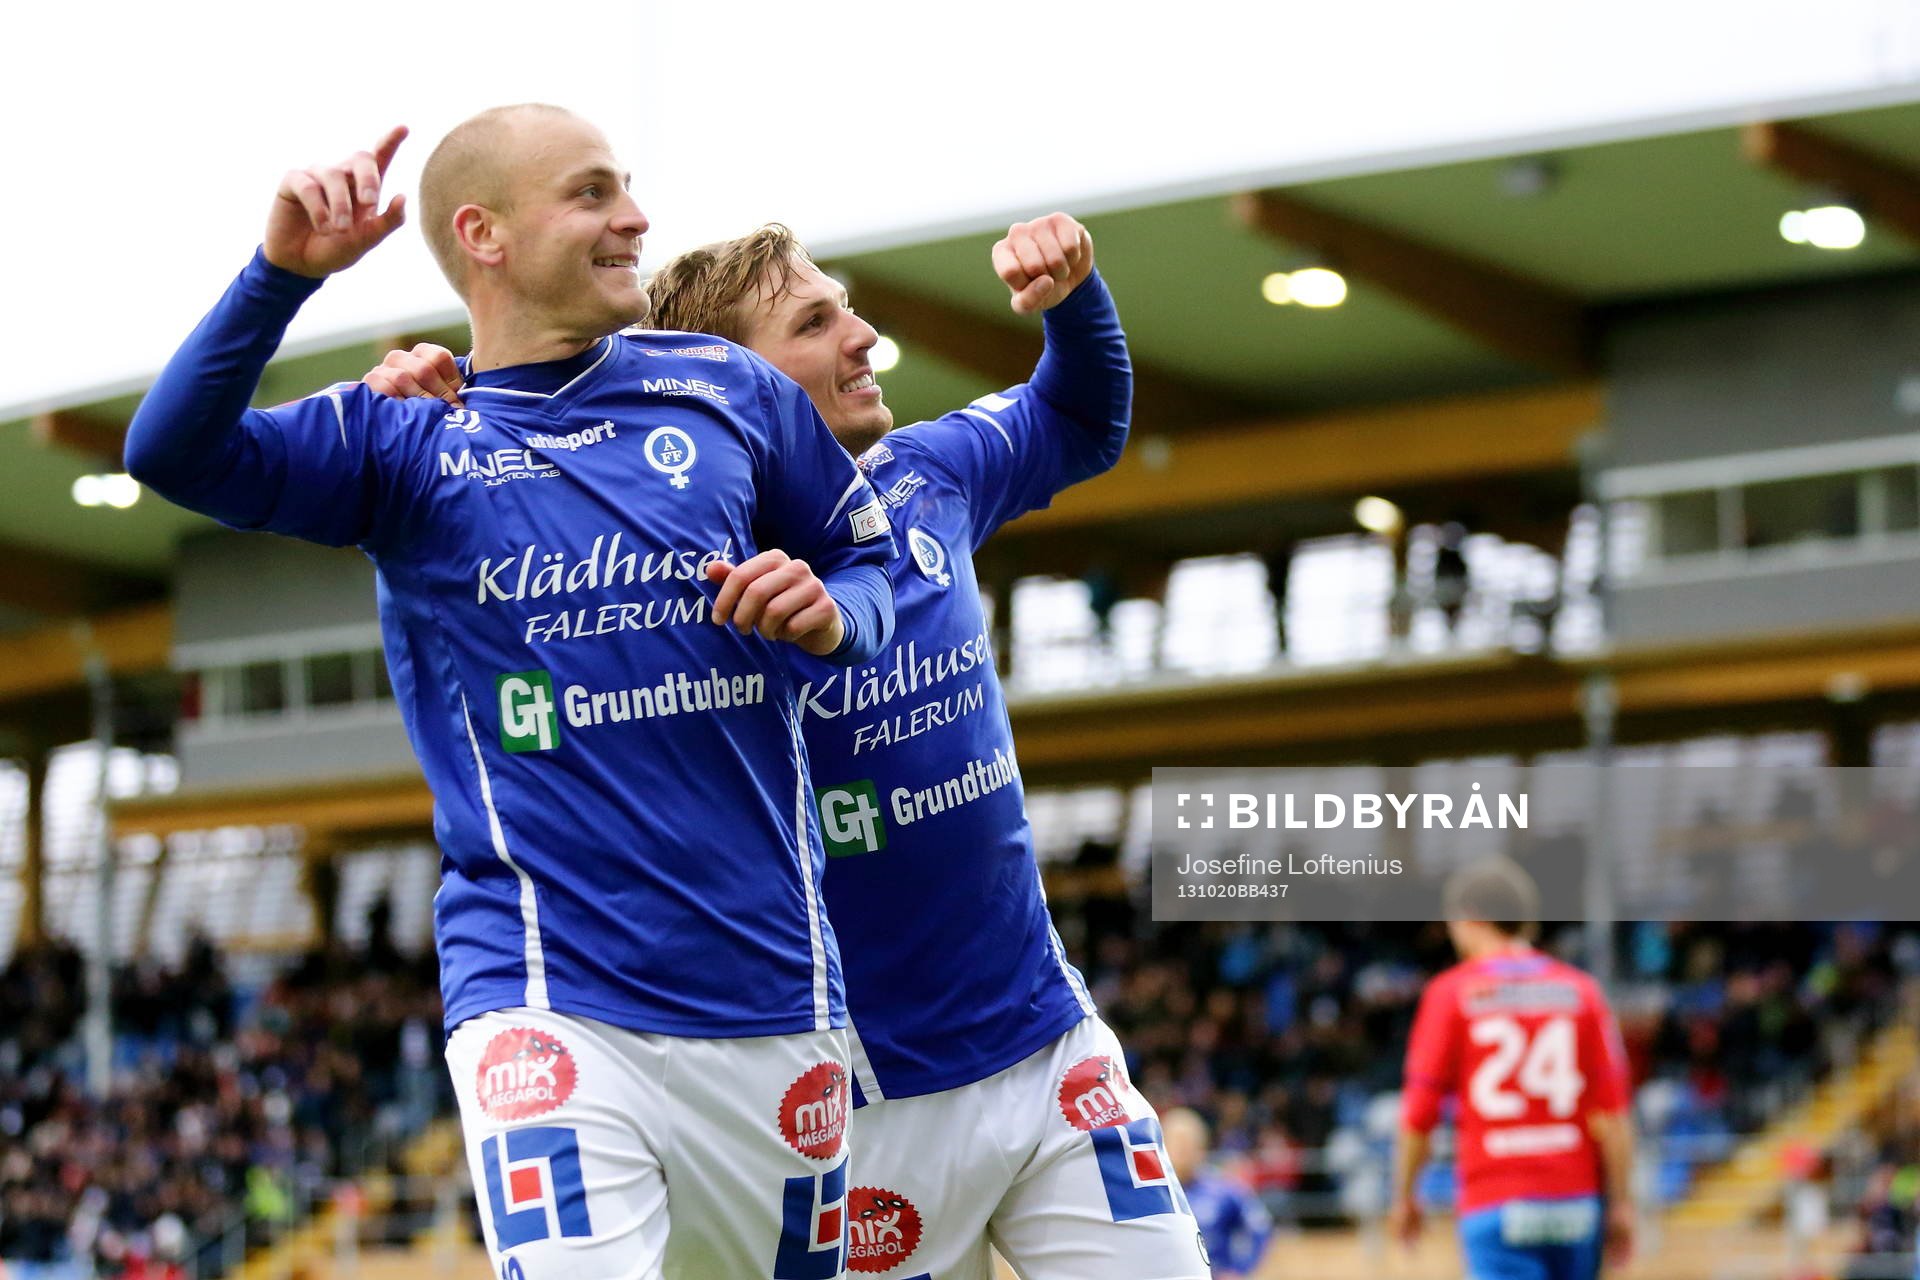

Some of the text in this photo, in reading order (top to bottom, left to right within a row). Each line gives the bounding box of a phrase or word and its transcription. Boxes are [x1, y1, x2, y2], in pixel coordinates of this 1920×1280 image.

[642, 378, 727, 400] MINEC
[526, 420, 617, 451] uhlsport
[466, 471, 535, 487] PRDUKTION
[478, 532, 733, 604] Klädhuset
[525, 596, 706, 644] FALERUM
[565, 666, 764, 728] Grundtuben
[853, 683, 984, 756] FALERUM
[890, 745, 1019, 826] Grundtube
[483, 1053, 558, 1097] mix
[1468, 1015, 1585, 1121] 24
[487, 1086, 558, 1109] MEGAPOL
[795, 1085, 842, 1134] mix
[1089, 1104, 1127, 1129] MEGA
[797, 1121, 843, 1148] MEGAPO
[847, 1241, 906, 1258] EGAPOL
